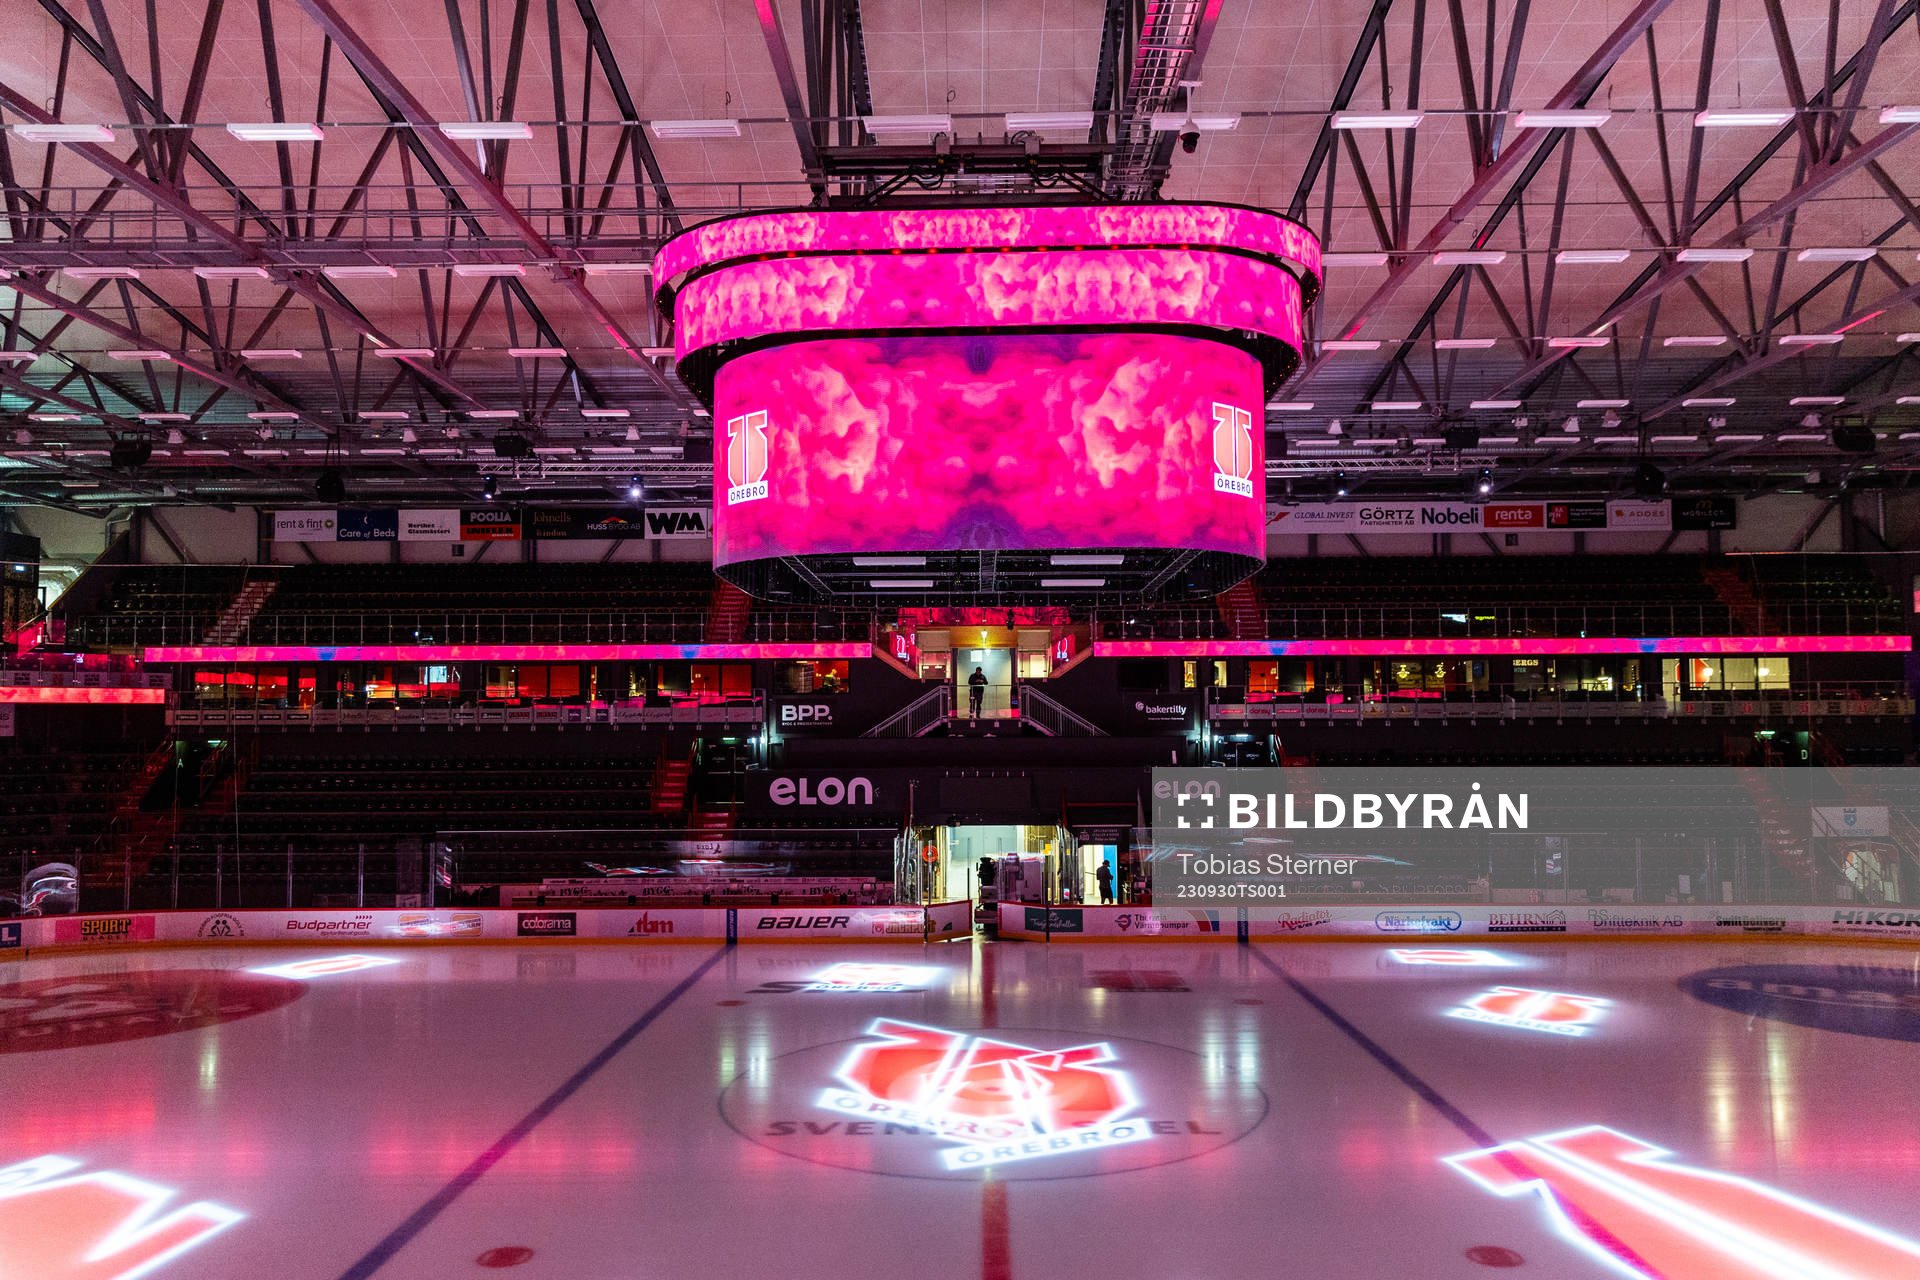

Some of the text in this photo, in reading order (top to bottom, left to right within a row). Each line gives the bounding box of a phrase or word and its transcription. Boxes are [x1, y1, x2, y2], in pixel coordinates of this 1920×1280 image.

[1217, 475, 1251, 495] ÖREBRO
[730, 485, 766, 502] ÖREBRO
[1359, 507, 1415, 520] GÖRTZ
[1421, 507, 1479, 525] Nobeli
[1494, 509, 1534, 521] renta
[277, 519, 297, 529] rent
[298, 520, 305, 529] &
[340, 529, 362, 539] Care
[374, 528, 397, 538] Beds
[1145, 704, 1187, 716] bakertilly
[1800, 749, 1808, 760] D
[521, 916, 572, 929] colorama
[1488, 913, 1547, 925] BEHRN
[1663, 915, 1684, 927] AB
[81, 919, 131, 935] SPORT
[286, 920, 372, 931] Budpartner
